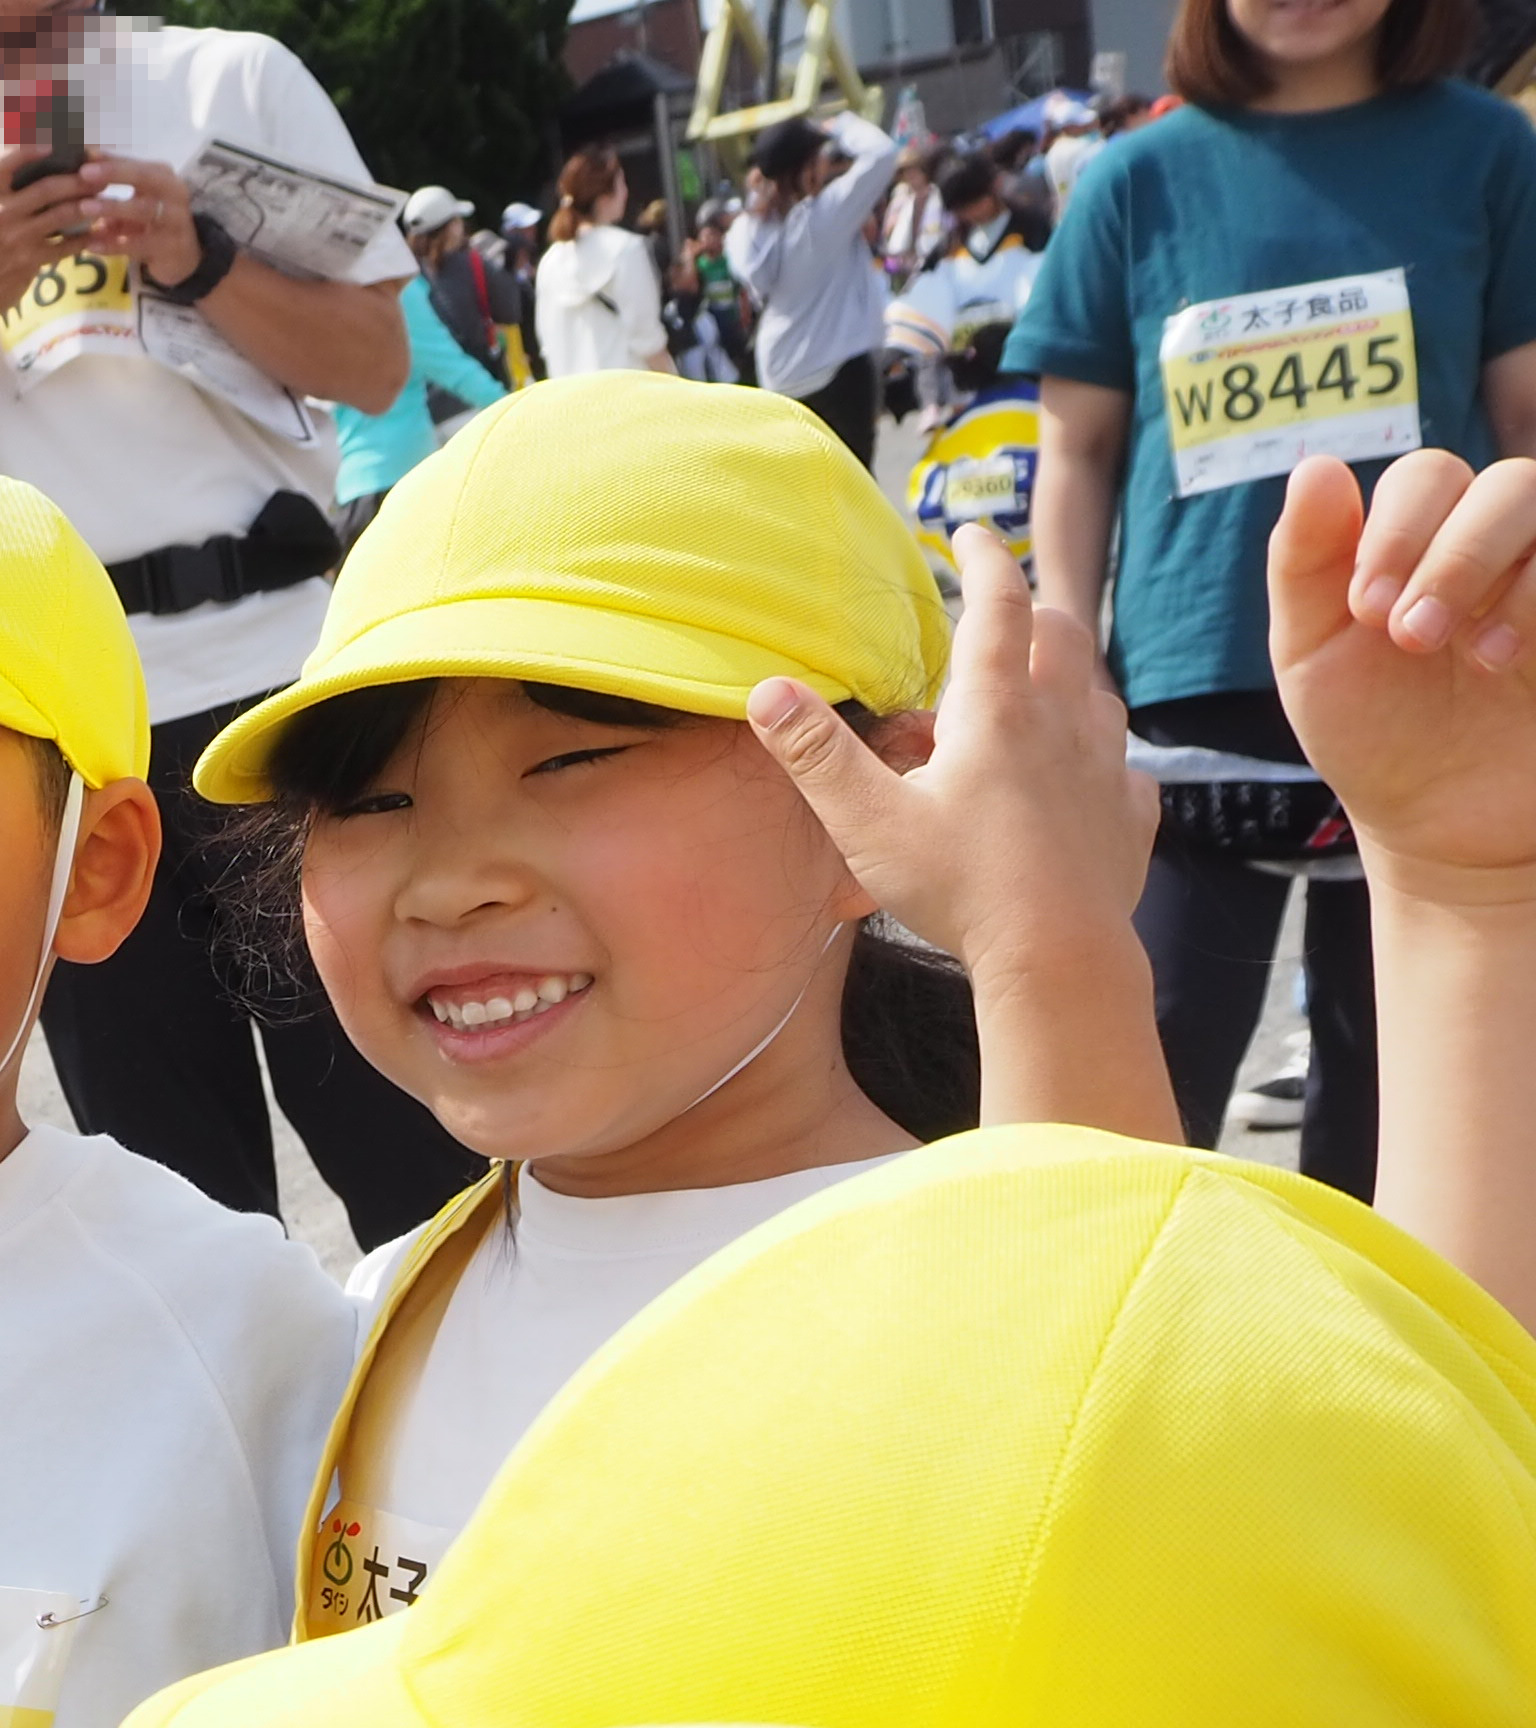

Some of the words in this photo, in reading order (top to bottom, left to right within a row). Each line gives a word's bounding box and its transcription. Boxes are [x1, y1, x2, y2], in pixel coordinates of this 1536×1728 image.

[1241, 286, 1368, 333] 太子食品
[1174, 334, 1405, 427] W8445
[321, 1587, 349, 1616] タイシ
